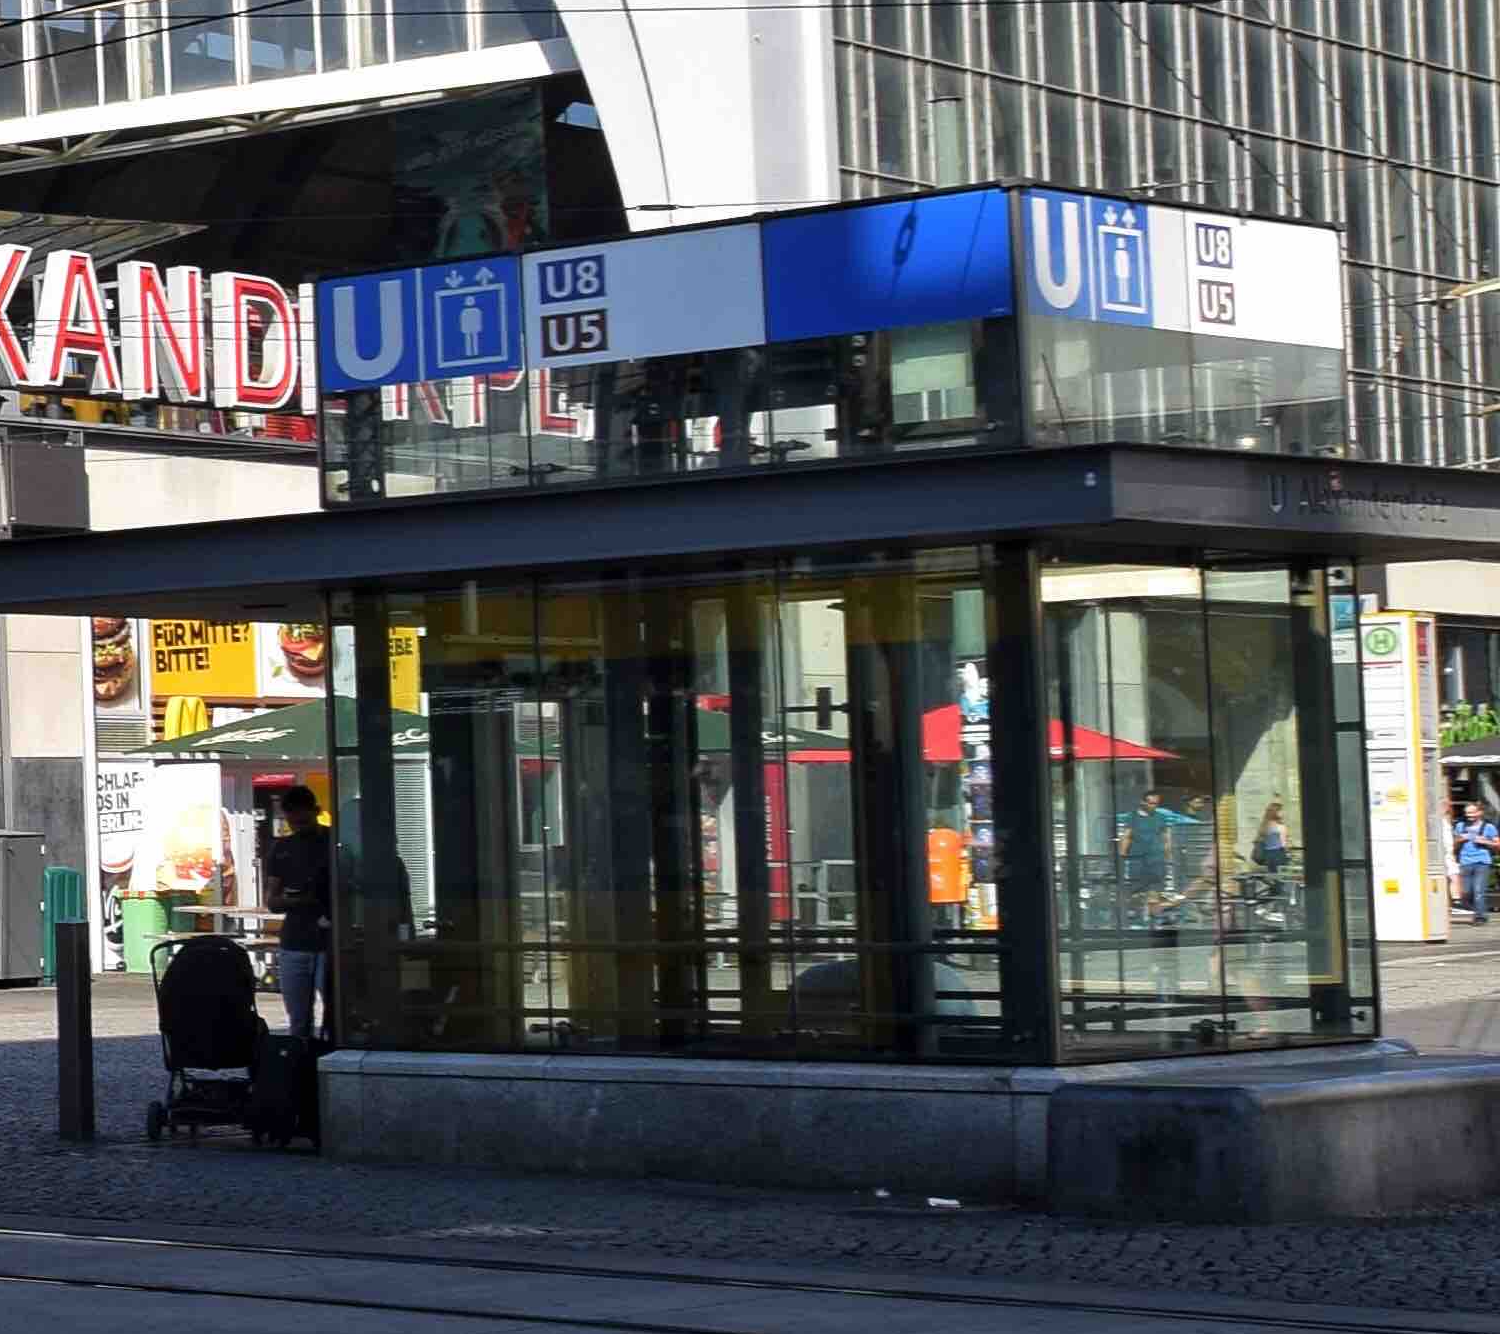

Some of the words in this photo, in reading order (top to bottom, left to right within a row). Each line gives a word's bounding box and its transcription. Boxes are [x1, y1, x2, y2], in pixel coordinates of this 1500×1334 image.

[1031, 197, 1082, 309] U
[1198, 225, 1230, 265] U8
[545, 260, 600, 299] U8
[1202, 281, 1234, 322] U5
[333, 278, 404, 381] U
[547, 313, 603, 353] U5
[154, 621, 186, 647] FÜR
[192, 620, 251, 646] MITTE?
[155, 648, 210, 673] BITTE!
[97, 772, 144, 791] CHLAF-
[97, 793, 114, 810] OS
[117, 792, 130, 809] IN
